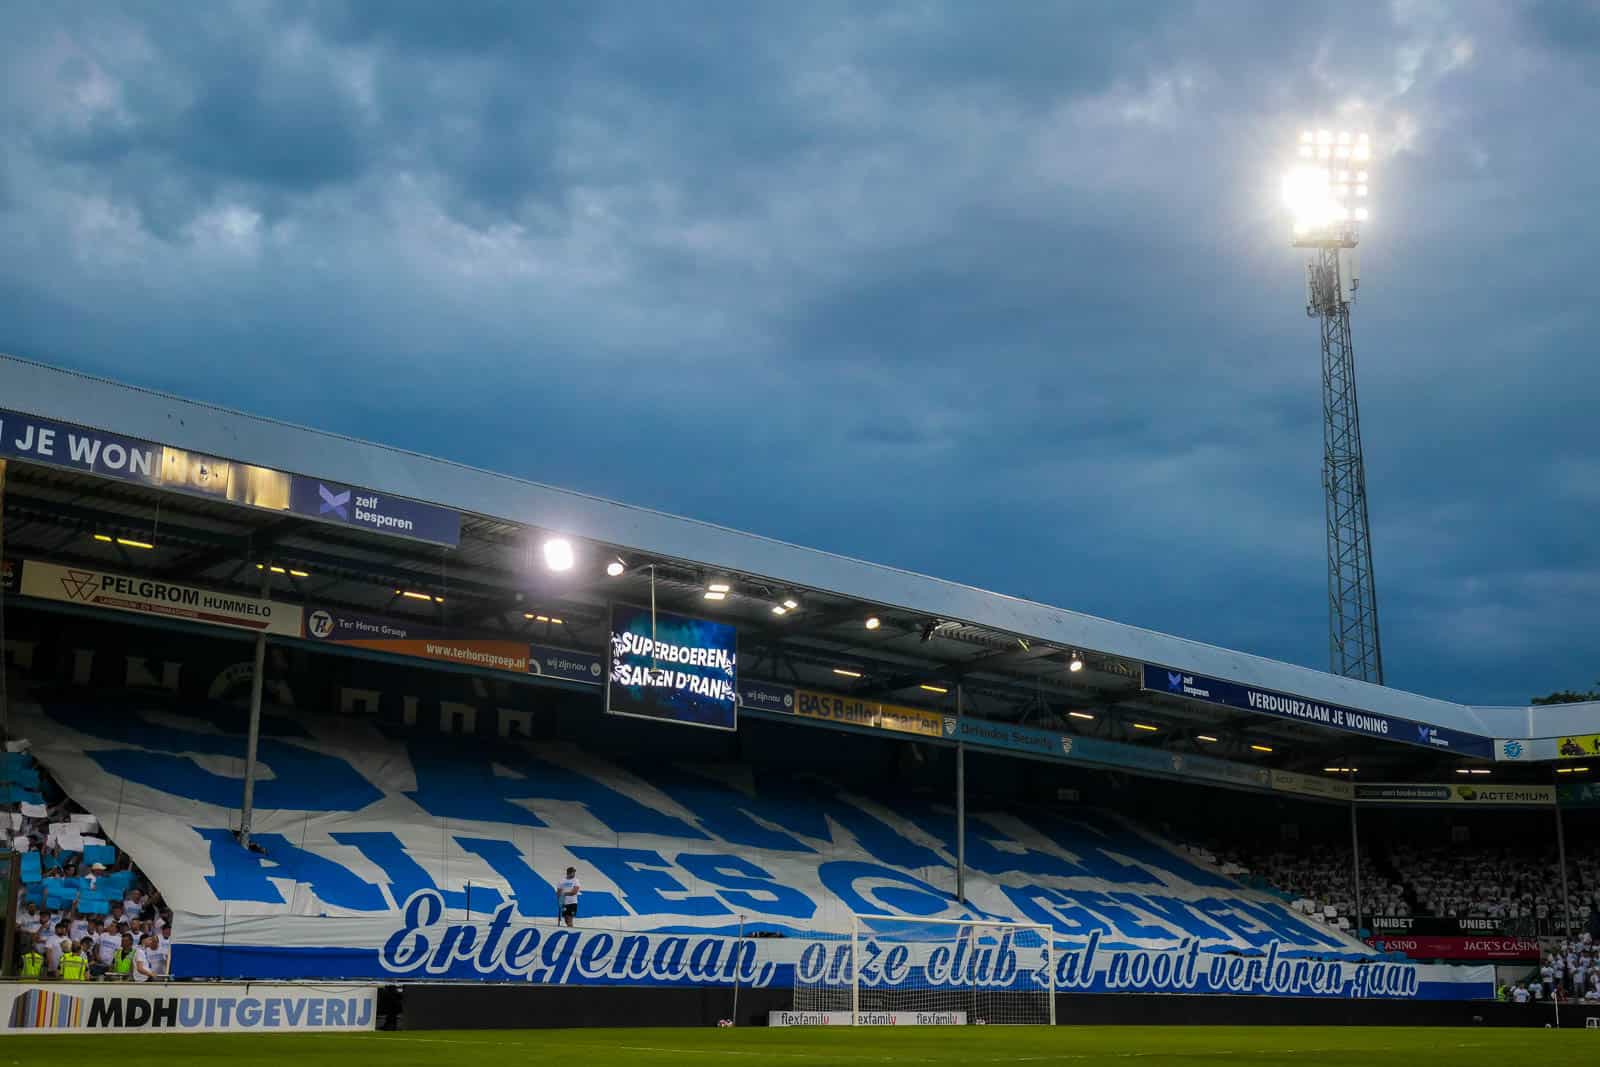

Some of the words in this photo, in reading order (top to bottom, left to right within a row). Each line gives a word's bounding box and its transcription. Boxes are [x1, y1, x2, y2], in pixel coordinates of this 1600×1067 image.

[15, 425, 56, 456] JE
[355, 496, 378, 509] zelf
[355, 508, 413, 530] besparen
[102, 575, 200, 605] PELGROM
[203, 596, 272, 617] HUMMELO
[426, 643, 526, 669] www.terhorstgroep.nl
[621, 664, 673, 688] SAMEN
[799, 694, 831, 717] BAS
[833, 699, 939, 733] Balloaarten
[1247, 691, 1330, 722] VERDUURZAAM
[1332, 710, 1344, 725] JE
[1346, 712, 1388, 734] WONING
[1480, 792, 1549, 801] ACTEMIUM
[195, 827, 818, 918] ALLES
[1000, 884, 1351, 948] GEVEN
[1372, 918, 1415, 929] UNIBET
[1459, 919, 1502, 929] UNIBET
[797, 939, 911, 985] onze
[925, 918, 1019, 987] club
[1030, 928, 1102, 989] zal
[1105, 936, 1204, 989] nooit
[1206, 939, 1348, 993] verloren
[1350, 963, 1421, 998] gaan
[1384, 941, 1417, 951] ASINO
[1463, 941, 1499, 951] JACK'S
